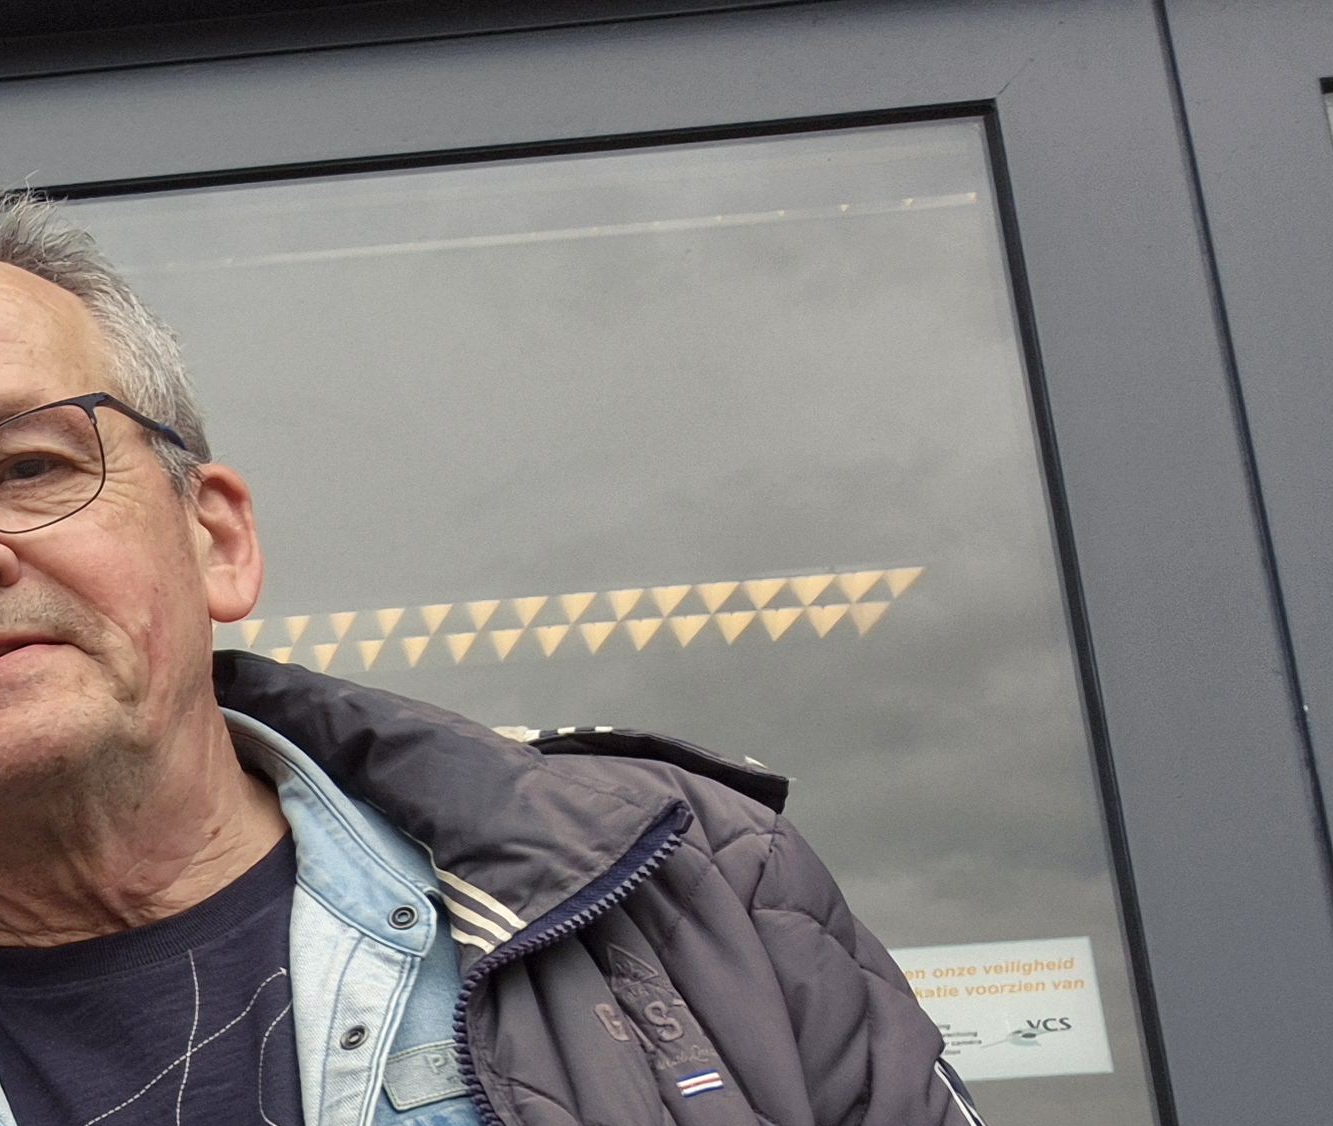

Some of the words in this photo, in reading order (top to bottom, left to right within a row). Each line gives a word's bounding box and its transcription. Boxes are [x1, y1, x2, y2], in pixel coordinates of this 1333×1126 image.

[933, 964, 977, 979] onze
[984, 956, 1076, 977] veiligheid
[965, 980, 1050, 996] voorzien
[1052, 977, 1086, 991] van
[1026, 1016, 1073, 1032] VCS
